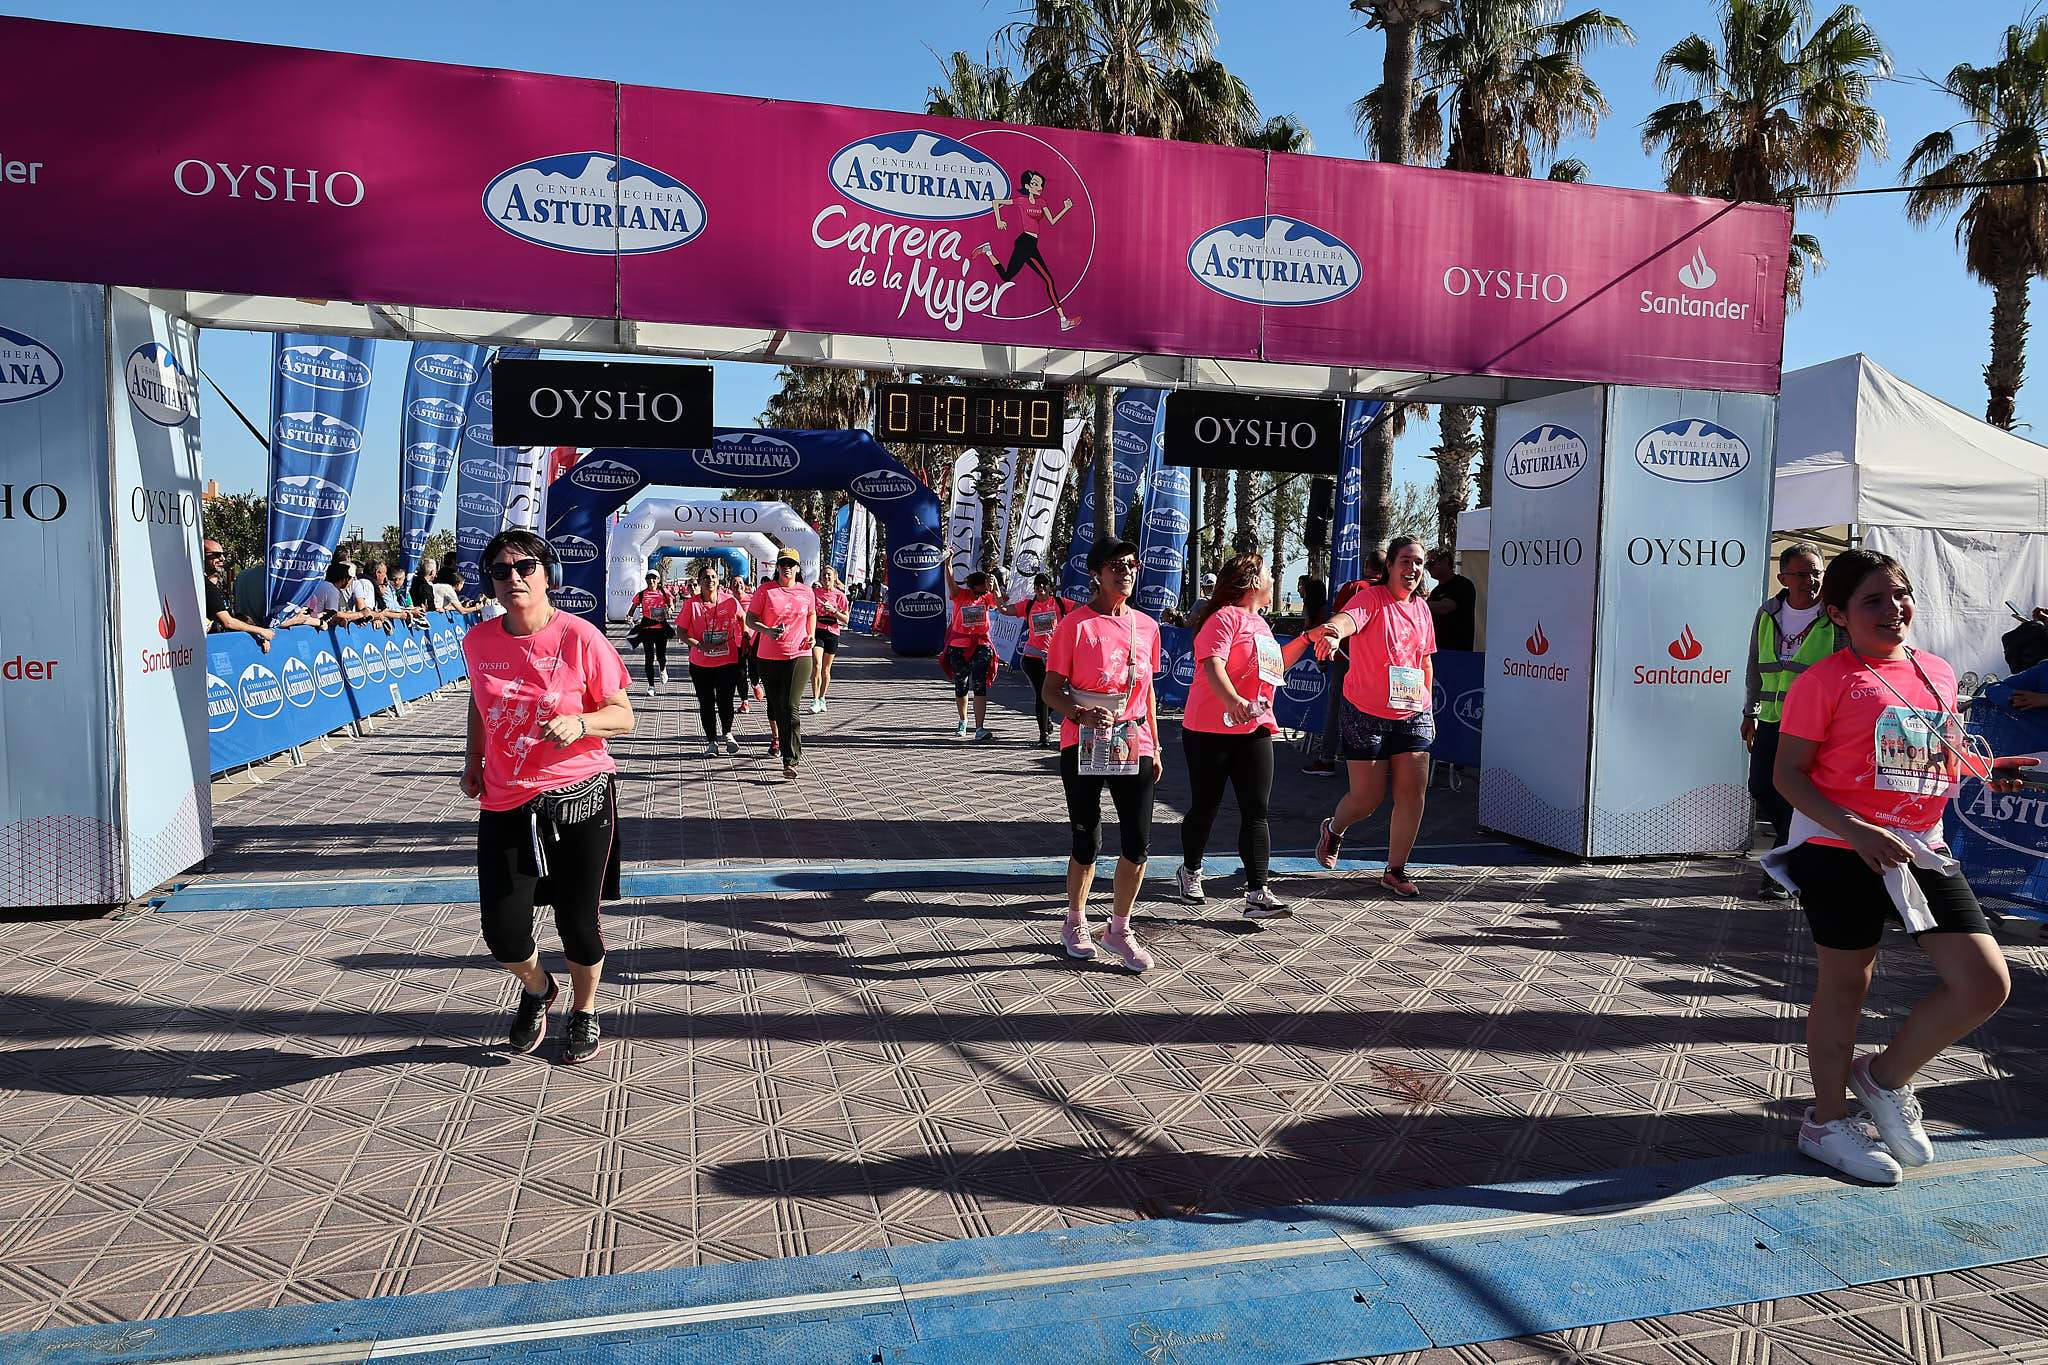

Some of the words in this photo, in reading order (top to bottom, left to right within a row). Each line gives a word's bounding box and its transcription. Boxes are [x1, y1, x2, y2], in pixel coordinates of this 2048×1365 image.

[872, 156, 930, 170] CENTRAL
[935, 163, 993, 177] LECHERA
[173, 159, 365, 207] OYSHO
[843, 155, 996, 202] ASTURIANA
[536, 183, 606, 199] CENTRAL
[500, 183, 690, 233] ASTURIANA
[811, 204, 963, 260] Carrera
[1229, 243, 1284, 256] CENTRAL
[1289, 248, 1344, 261] LECHERA
[848, 255, 877, 288] de
[883, 257, 903, 290] la
[1201, 243, 1349, 287] ASTURIANA
[897, 257, 1016, 332] Mujer
[1443, 266, 1568, 303] OYSHO
[1640, 290, 1750, 321] Santander
[3, 350, 41, 360] HERA
[281, 353, 364, 384] ASTURIANA
[131, 364, 190, 412] ASTURIANA
[529, 387, 684, 423] OYSHO
[888, 392, 1051, 438] 01:01:48
[279, 421, 357, 450] ASTURIANA
[1194, 416, 1317, 450] OYSHO
[1113, 438, 1145, 452] STURIANA
[1521, 445, 1548, 456] CENTRAL
[1549, 442, 1579, 452] LECHERA
[1642, 440, 1741, 469] ASTURIANA
[1661, 439, 1697, 448] CENTRAL
[1700, 441, 1738, 450] LECHERA
[407, 449, 452, 468] ASTURIAN
[700, 448, 793, 468] ASTURIANA
[1509, 451, 1581, 476] ASTURIANA
[463, 463, 507, 481] ASTURIANA
[574, 470, 636, 484] ASTURIANA
[1113, 471, 1134, 482] RIANA
[855, 481, 913, 493] ASTURIANA
[1152, 477, 1190, 493] ASTURIAN
[131, 486, 195, 528] OYSHO
[674, 505, 759, 525] OYSHO
[1016, 448, 1067, 578] OYSHO
[548, 547, 595, 558] ATURIANA
[1501, 537, 1583, 567] OYSHO
[1627, 537, 1746, 568] OYSHO
[898, 602, 943, 613] ASTURIANA
[142, 646, 193, 674] Santander
[478, 661, 510, 671] OYSHO
[1174, 662, 1194, 677] ASTURI
[1503, 657, 1570, 682] Santander
[1286, 673, 1321, 693] ASTURIANA
[1633, 665, 1732, 685] Santander
[207, 697, 236, 717] URIANA
[242, 686, 282, 708] ASTURIANA
[1887, 778, 1916, 788] OYSHO
